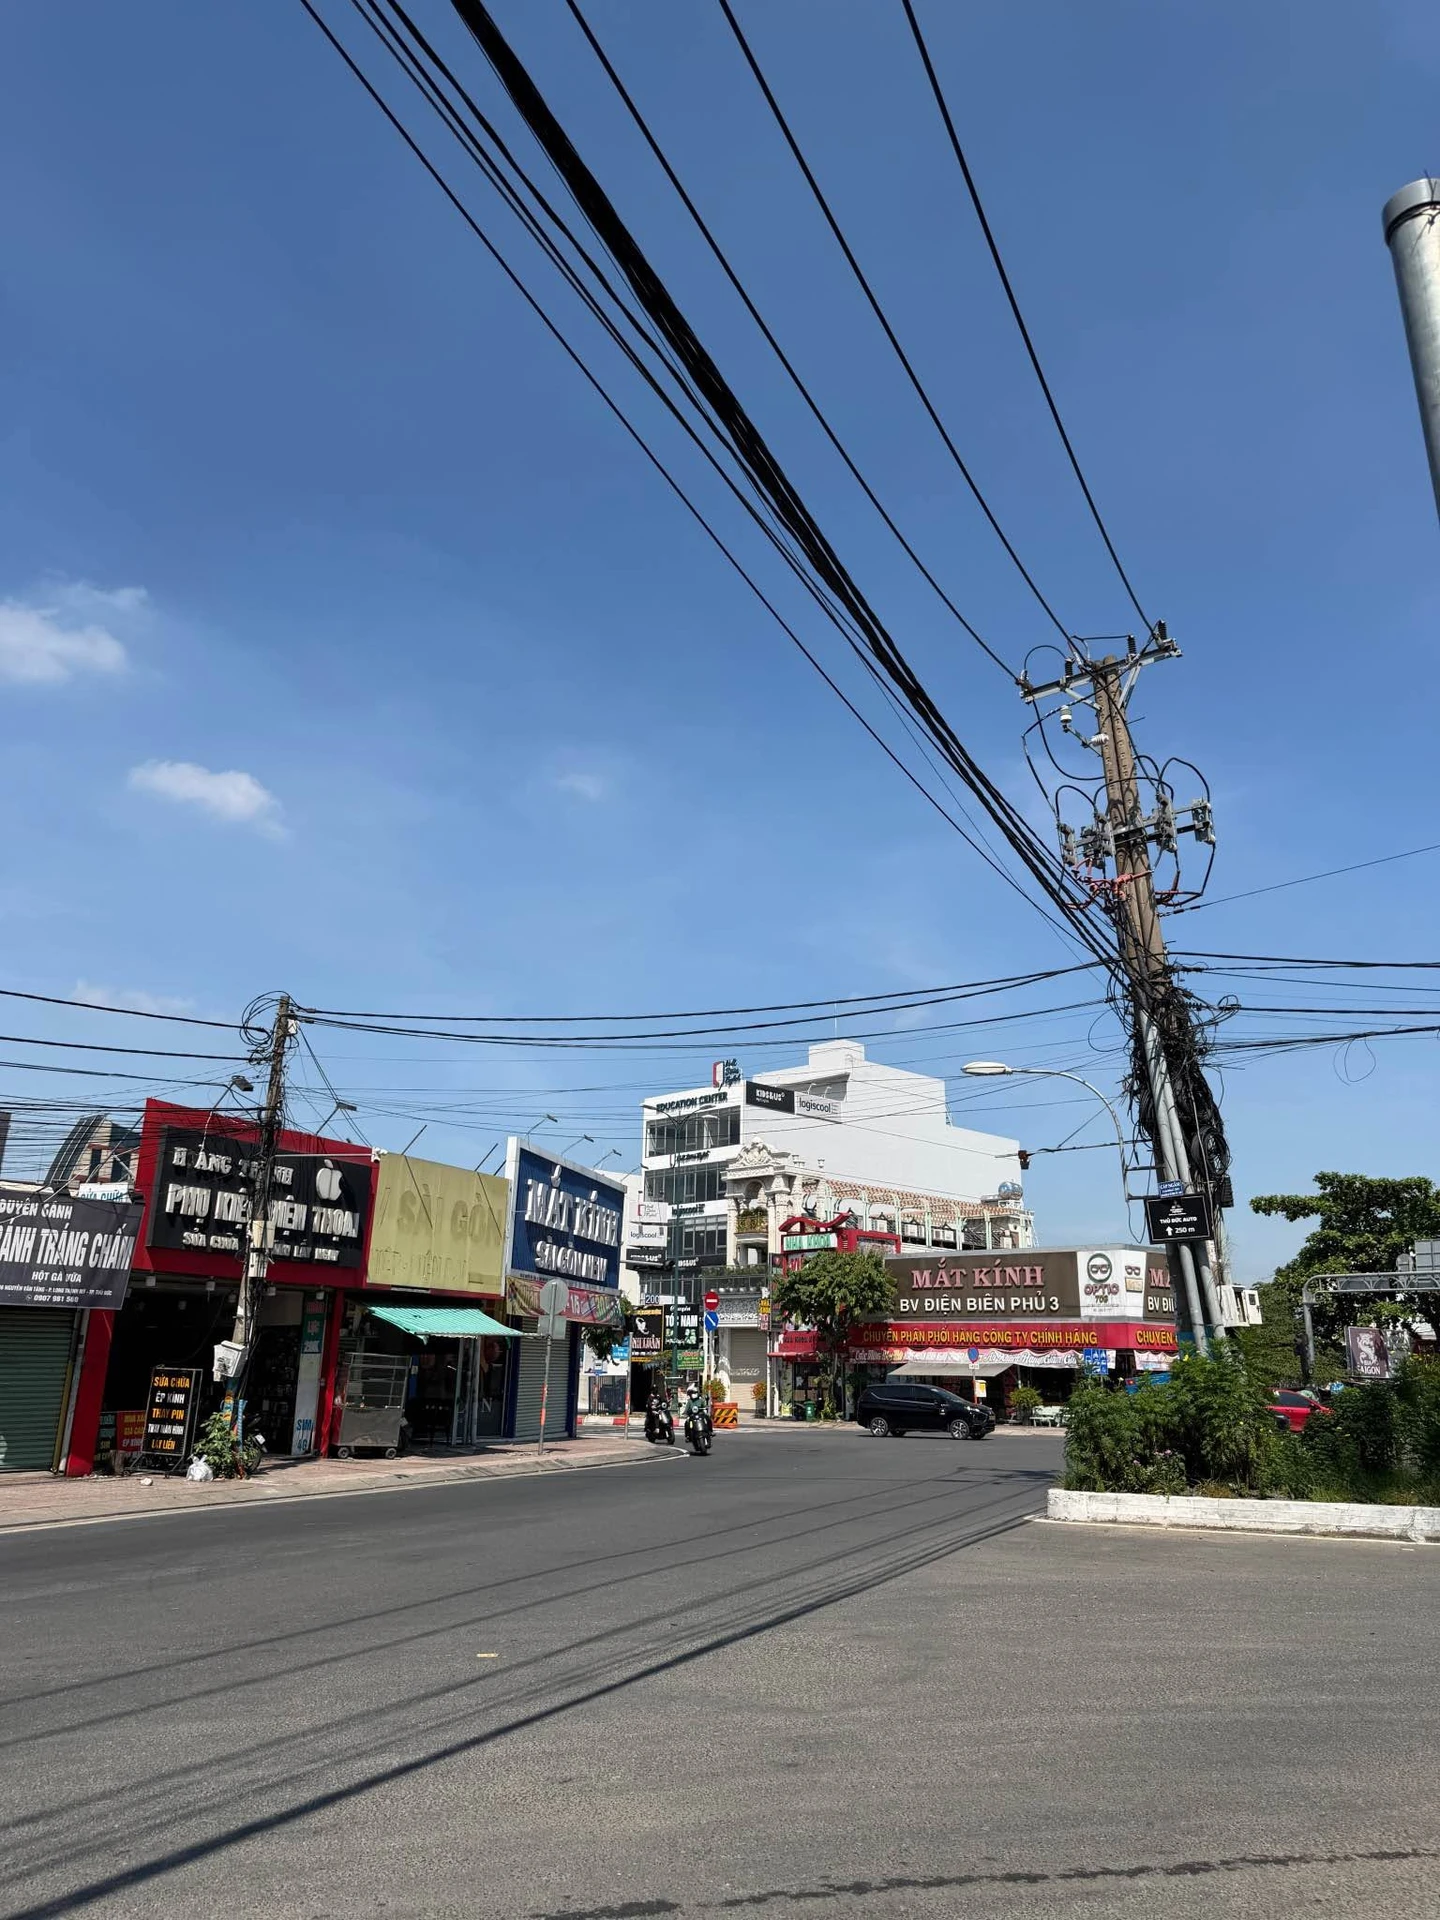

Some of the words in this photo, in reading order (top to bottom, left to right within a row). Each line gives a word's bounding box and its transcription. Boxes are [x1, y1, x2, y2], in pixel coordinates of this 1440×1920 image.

[655, 1098, 697, 1112] EDUCATION
[698, 1091, 728, 1105] CENTER
[799, 1097, 831, 1113] logiscool
[165, 1183, 211, 1224] PHỤ
[311, 1206, 360, 1242] THOẠI
[525, 1165, 574, 1233] MẮT
[573, 1190, 620, 1247] KÍNH
[1174, 1226, 1188, 1234] 250
[36, 1222, 89, 1267] TRÁNG
[89, 1223, 135, 1270] CHẤM
[182, 1227, 207, 1247] SỬA
[210, 1232, 239, 1251] CHỮA
[535, 1235, 557, 1271] SÀI
[556, 1241, 583, 1277] GÒN
[582, 1253, 608, 1281] NEW
[32, 1270, 50, 1282] HỘT
[51, 1271, 63, 1282] GÀ
[912, 1257, 967, 1289] MẮT
[972, 1258, 1045, 1288] KÍNH
[1084, 1283, 1120, 1296] OPTIC
[900, 1298, 920, 1312] BV
[924, 1293, 962, 1316] ĐIỆN
[966, 1293, 1005, 1312] BIÊN
[1010, 1290, 1046, 1312] PHỦ
[1049, 1296, 1060, 1311] 3
[1147, 1297, 1160, 1312] BV
[680, 1315, 698, 1328] NAM
[863, 1328, 898, 1343] CHUYÊN
[900, 1328, 925, 1343] PHÂN
[928, 1325, 950, 1343] PHỐI
[952, 1328, 980, 1343] HÀNG
[982, 1329, 1012, 1344] CÔNG
[1015, 1331, 1029, 1343] TY
[1030, 1328, 1063, 1344] CHÍNH
[1065, 1328, 1098, 1344] HÃNG
[1136, 1328, 1174, 1344] CHUYÊN
[153, 1374, 168, 1387] SỬA
[170, 1376, 190, 1389] CHỮA
[155, 1391, 165, 1403] ÉP
[167, 1392, 185, 1404] KÍNH
[152, 1408, 170, 1419] THAY
[170, 1409, 185, 1420] PIN
[296, 1419, 313, 1431] SIM
[297, 1440, 308, 1450] 4G
